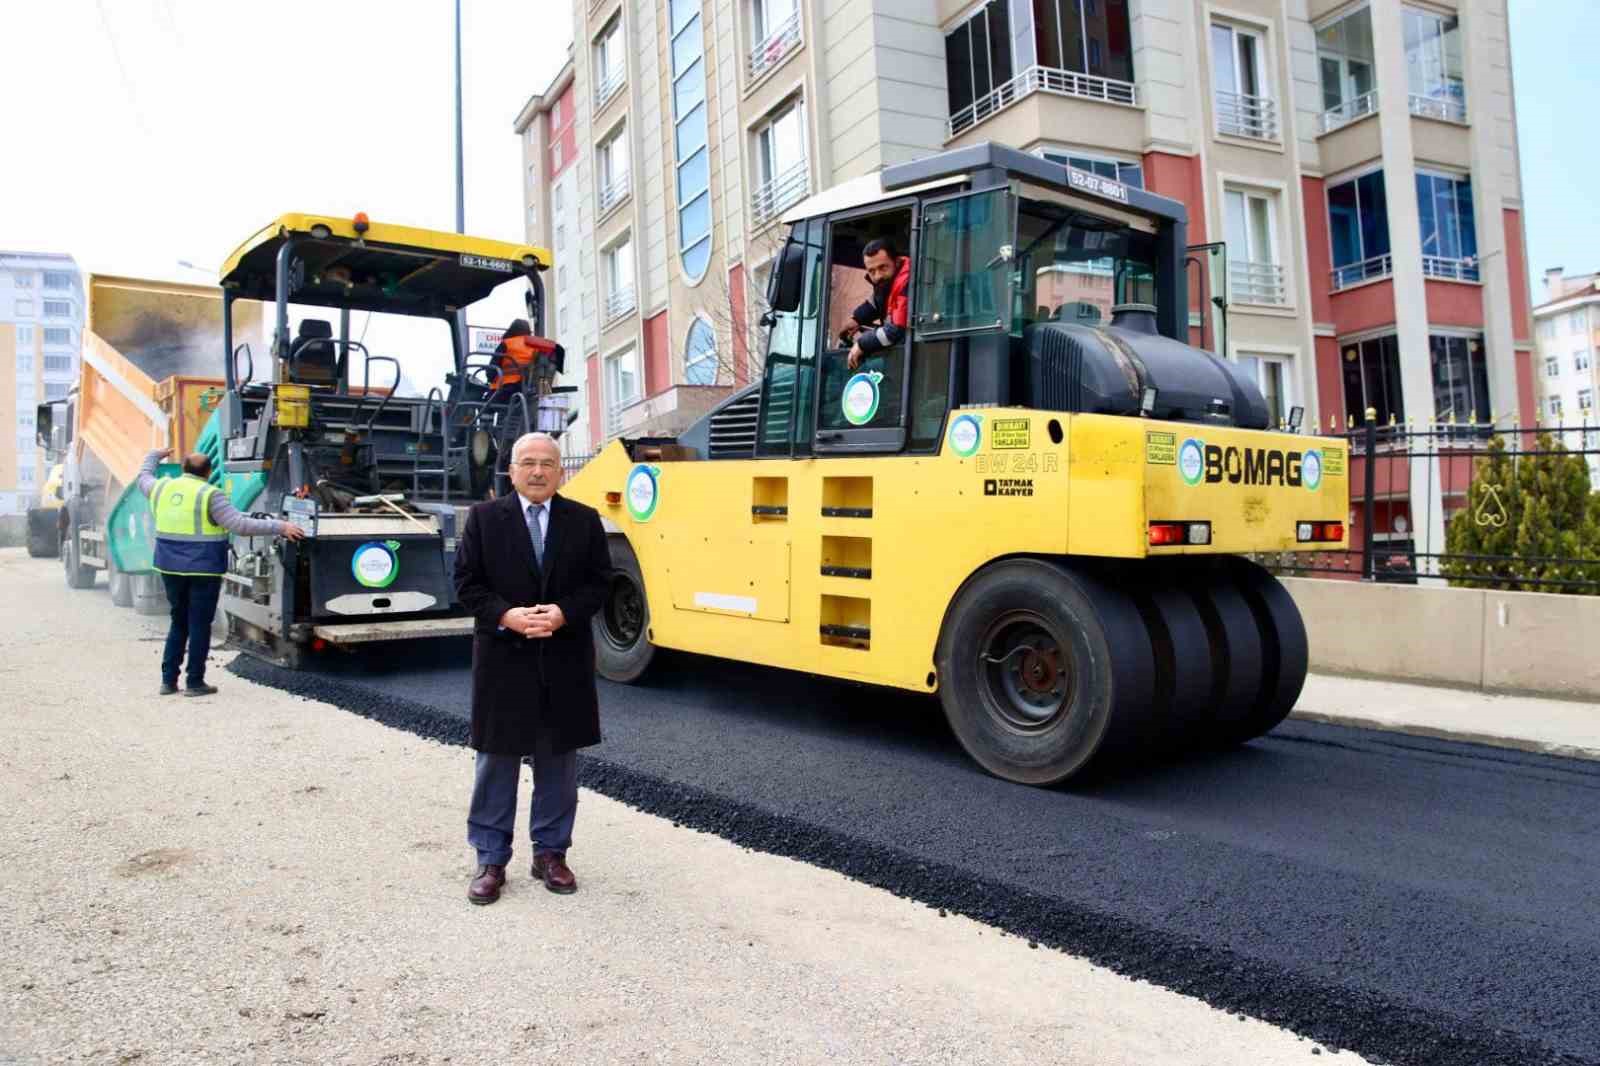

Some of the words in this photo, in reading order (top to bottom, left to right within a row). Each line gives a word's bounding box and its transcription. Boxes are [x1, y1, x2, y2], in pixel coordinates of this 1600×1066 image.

[975, 453, 1009, 473] BW
[1012, 452, 1038, 473] 24
[1043, 452, 1058, 472] R
[1205, 445, 1302, 487] BOMAG
[998, 479, 1033, 487] TATMAK
[998, 488, 1033, 496] KARYER
